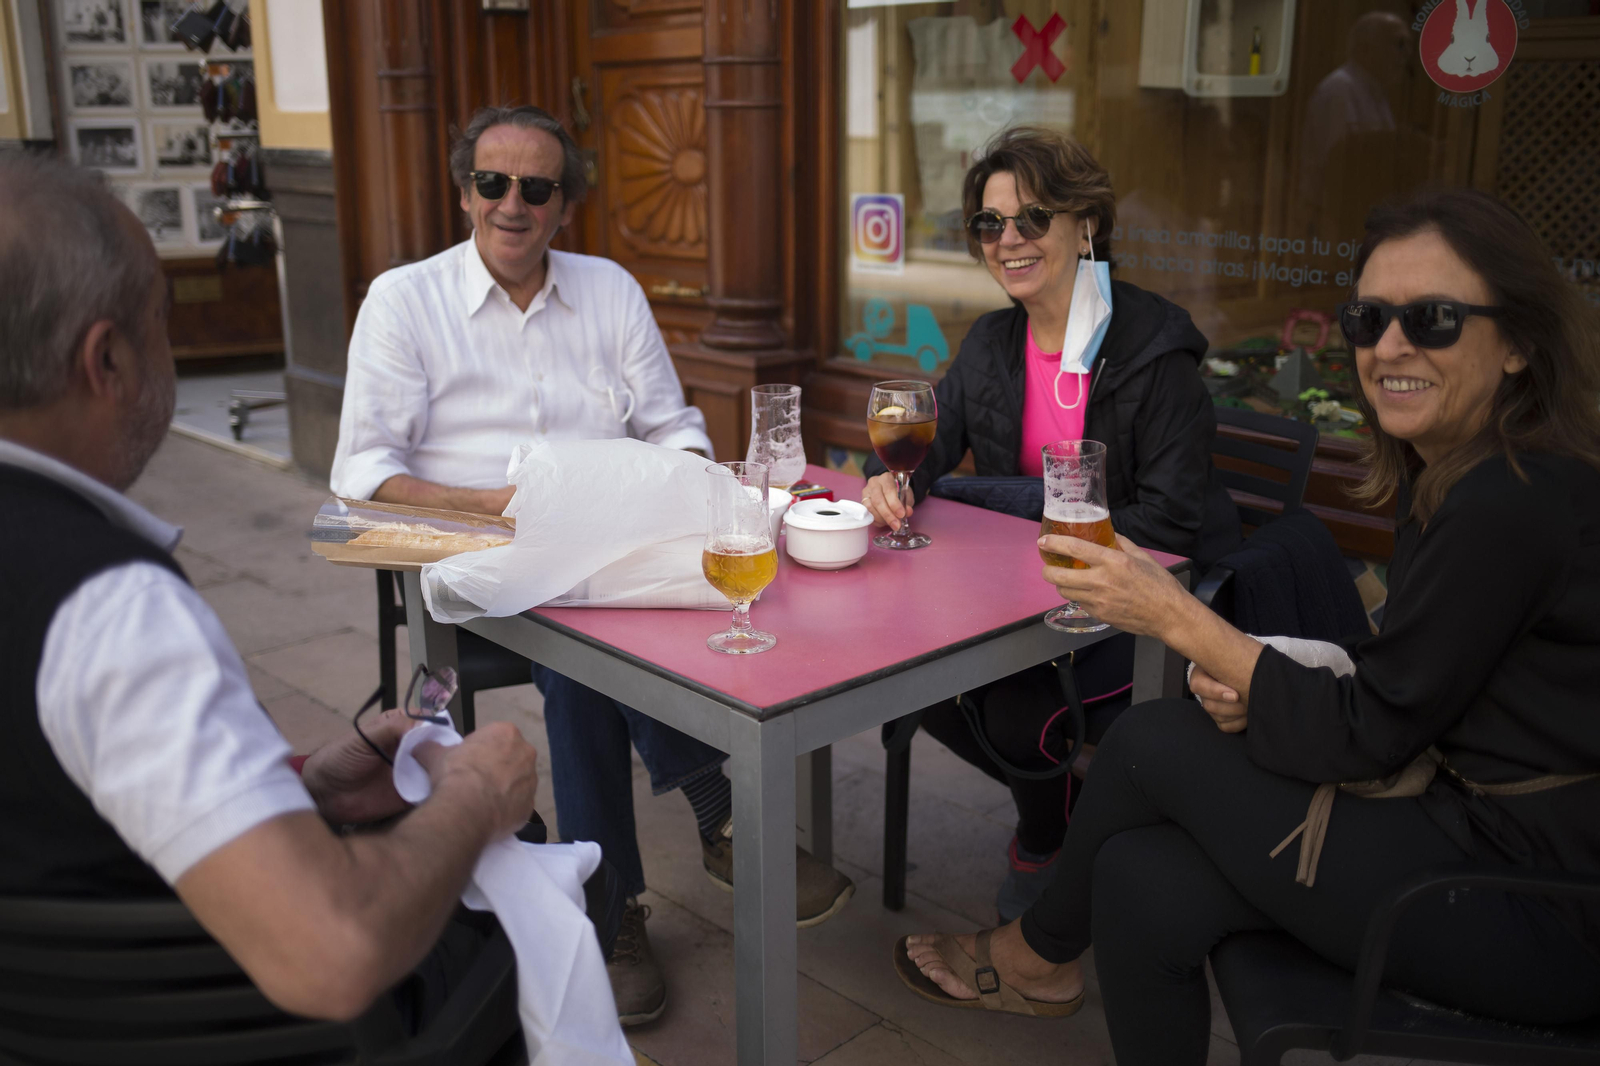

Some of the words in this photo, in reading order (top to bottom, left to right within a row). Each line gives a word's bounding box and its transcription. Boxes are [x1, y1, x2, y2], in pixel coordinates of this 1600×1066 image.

[1177, 230, 1255, 252] amarilla,
[1259, 233, 1306, 257] tapa
[1313, 236, 1332, 256] tu
[1111, 250, 1138, 268] do
[1143, 251, 1194, 273] hacia
[1253, 260, 1329, 288] ¡Magia:
